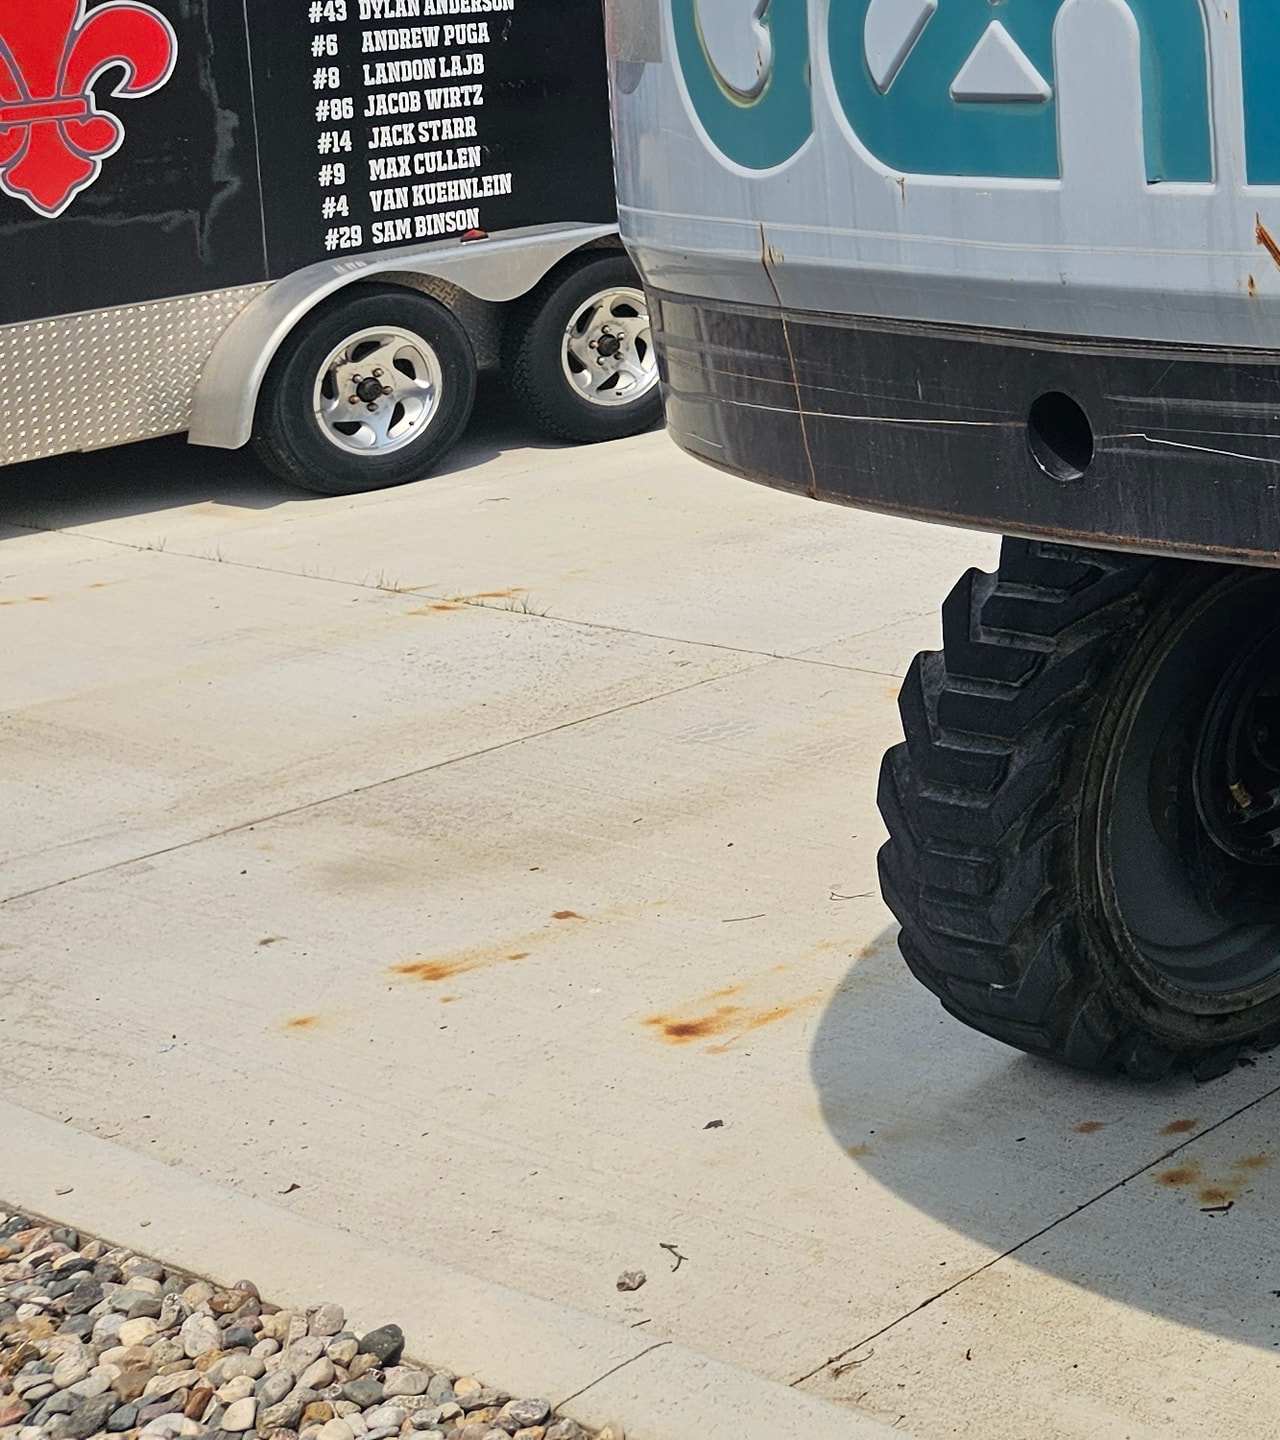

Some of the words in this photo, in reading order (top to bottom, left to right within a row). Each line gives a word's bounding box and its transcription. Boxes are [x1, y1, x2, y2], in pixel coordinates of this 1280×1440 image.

[308, 0, 347, 23] #43
[311, 34, 338, 57] #6
[361, 26, 440, 53] ANDREW
[444, 22, 490, 46] PUGA
[313, 67, 340, 89] #8
[363, 58, 436, 86] LANDON
[439, 53, 485, 78] LAJB
[315, 97, 354, 122] #86
[364, 91, 421, 117] JACOB
[424, 84, 484, 110] WIRTZ
[317, 130, 352, 154] #14
[369, 123, 416, 149] JACK
[418, 116, 478, 143] STARR
[319, 163, 345, 186] #9
[369, 155, 411, 181] MAX
[414, 146, 481, 174] CULLEN
[322, 195, 349, 219] #4
[370, 187, 409, 212] VAN
[412, 173, 512, 205] KUEHNLEIN
[325, 225, 362, 251] #29
[372, 218, 411, 244] SAM
[415, 208, 480, 237] BINSON
